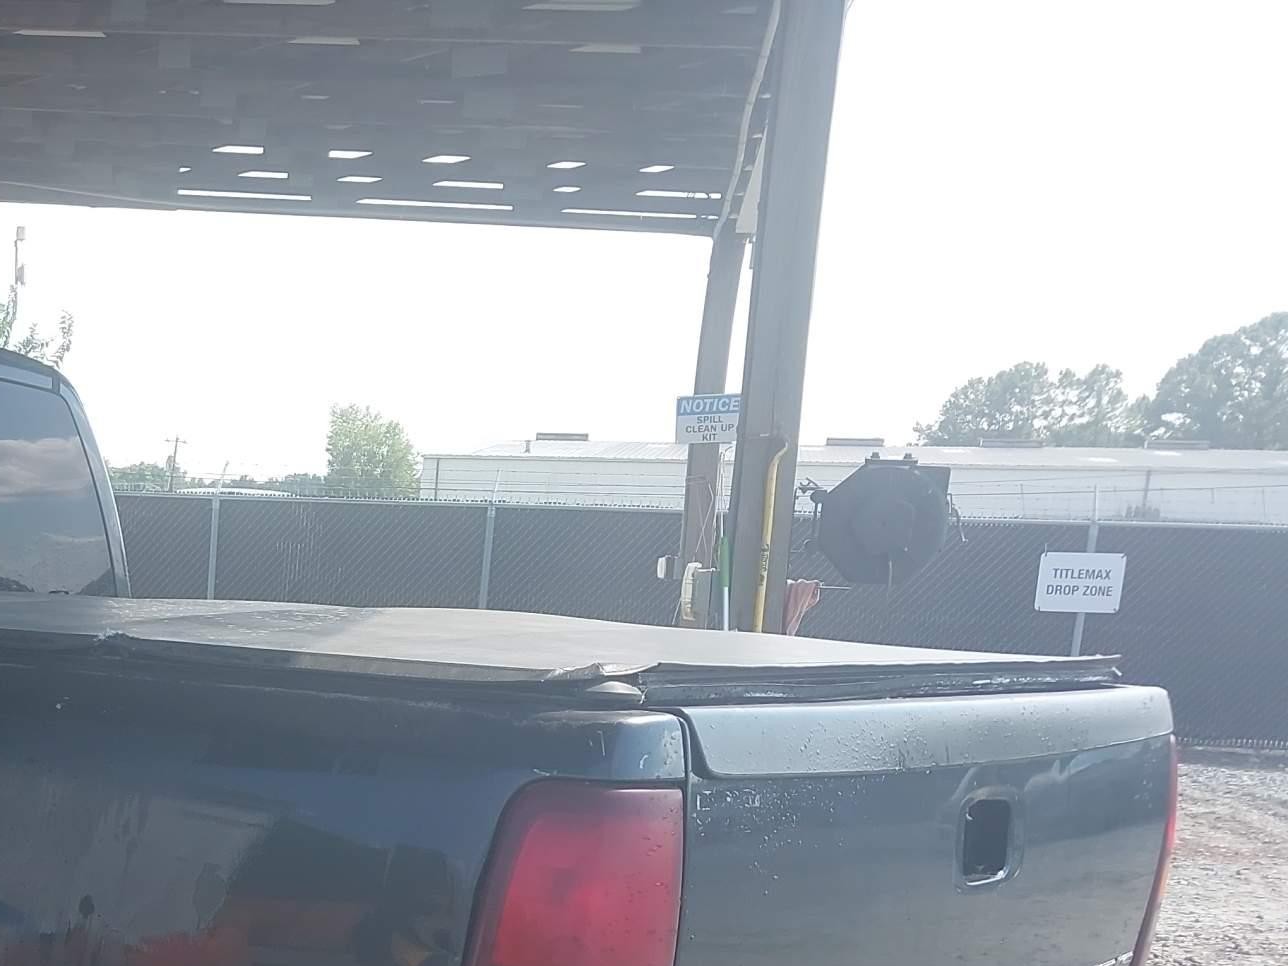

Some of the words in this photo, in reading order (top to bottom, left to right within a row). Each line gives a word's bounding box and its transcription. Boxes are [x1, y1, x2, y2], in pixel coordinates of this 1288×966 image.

[680, 397, 741, 413] NOTICE
[696, 415, 723, 424] SPILL
[685, 424, 717, 433] CLEAN
[720, 423, 734, 432] UP
[702, 433, 717, 441] KIT
[1053, 567, 1112, 580] TITLEMAX
[1046, 584, 1079, 595] DROP
[1082, 585, 1113, 597] ZONE
